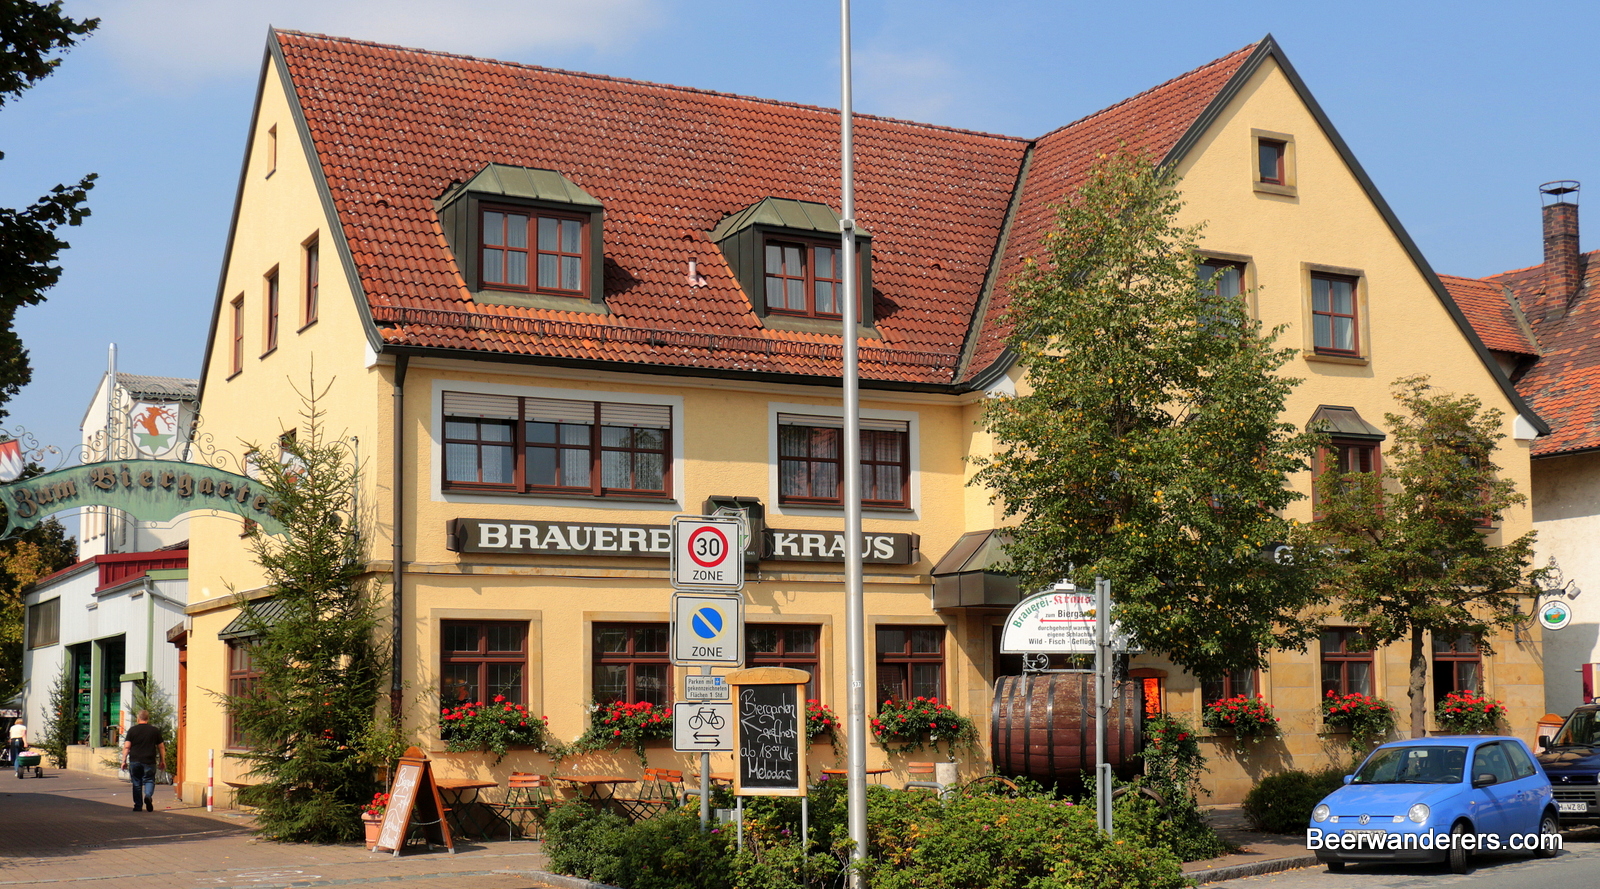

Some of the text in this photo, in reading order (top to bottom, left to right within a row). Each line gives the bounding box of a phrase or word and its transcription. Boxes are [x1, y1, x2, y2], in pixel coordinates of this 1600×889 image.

[15, 479, 77, 518] Zum
[478, 523, 671, 552] BRAUERE
[696, 538, 720, 556] 30
[692, 570, 723, 581] ZONE
[1071, 638, 1096, 646] Geflüge
[692, 646, 723, 657] ZONE
[734, 670, 796, 681] KRAUS
[740, 689, 796, 723] Biergarten
[740, 739, 756, 757] ab
